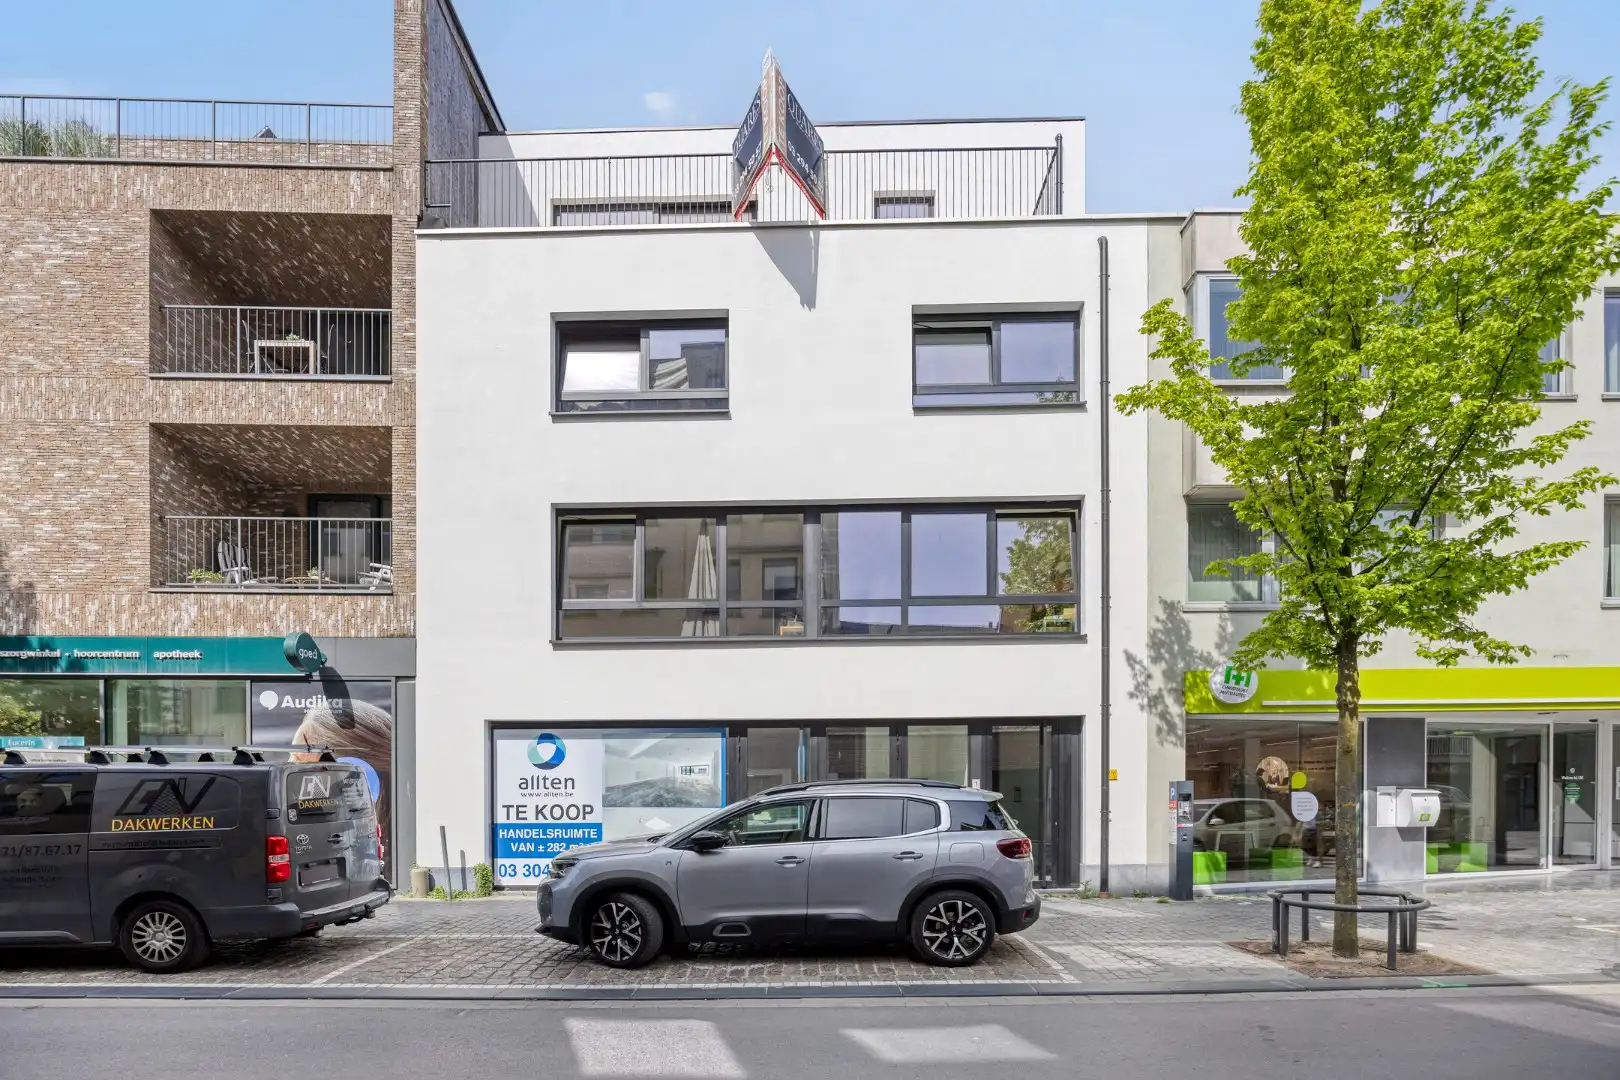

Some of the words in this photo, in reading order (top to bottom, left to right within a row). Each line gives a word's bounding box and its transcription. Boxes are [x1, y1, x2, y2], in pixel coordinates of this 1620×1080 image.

[796, 153, 809, 173] 294
[73, 649, 139, 658] hoorcentrum
[153, 649, 202, 659] apotheek
[298, 647, 318, 660] goed
[281, 694, 343, 708] Audika
[8, 738, 36, 747] Eucerin
[518, 774, 575, 790] allten
[299, 798, 339, 809] DAKWERKEN
[502, 804, 528, 820] TE
[535, 804, 594, 821] KOOP
[111, 816, 214, 832] DAKWERKEN
[499, 828, 598, 839] HANDELSRUIMTE
[511, 843, 535, 852] VAN
[537, 843, 545, 852] ±
[547, 843, 566, 852] 282
[498, 863, 517, 878] 03
[522, 863, 550, 878] 304
